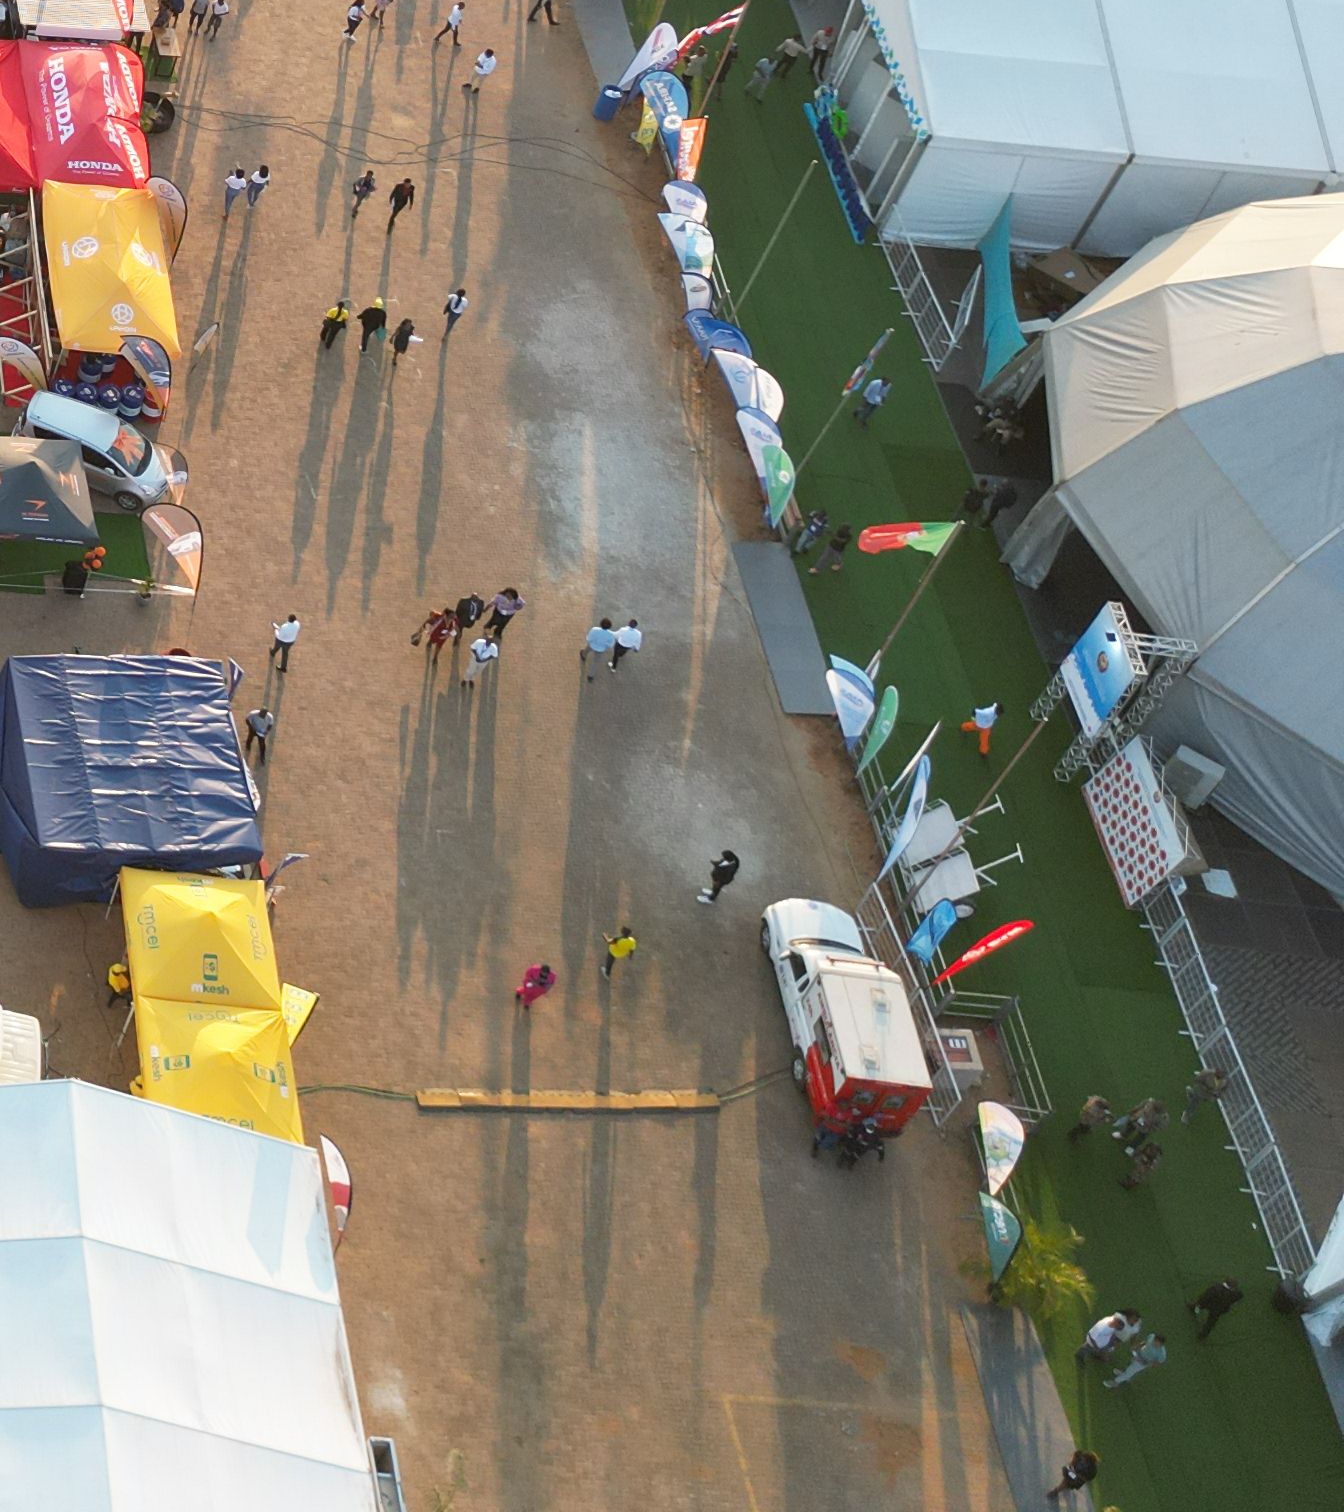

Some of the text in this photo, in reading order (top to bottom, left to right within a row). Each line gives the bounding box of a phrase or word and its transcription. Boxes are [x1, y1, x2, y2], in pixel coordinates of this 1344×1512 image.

[48, 59, 75, 145] HONDA
[67, 160, 123, 171] HONDA
[191, 983, 230, 995] mkesh
[149, 1045, 162, 1082] mkesh
